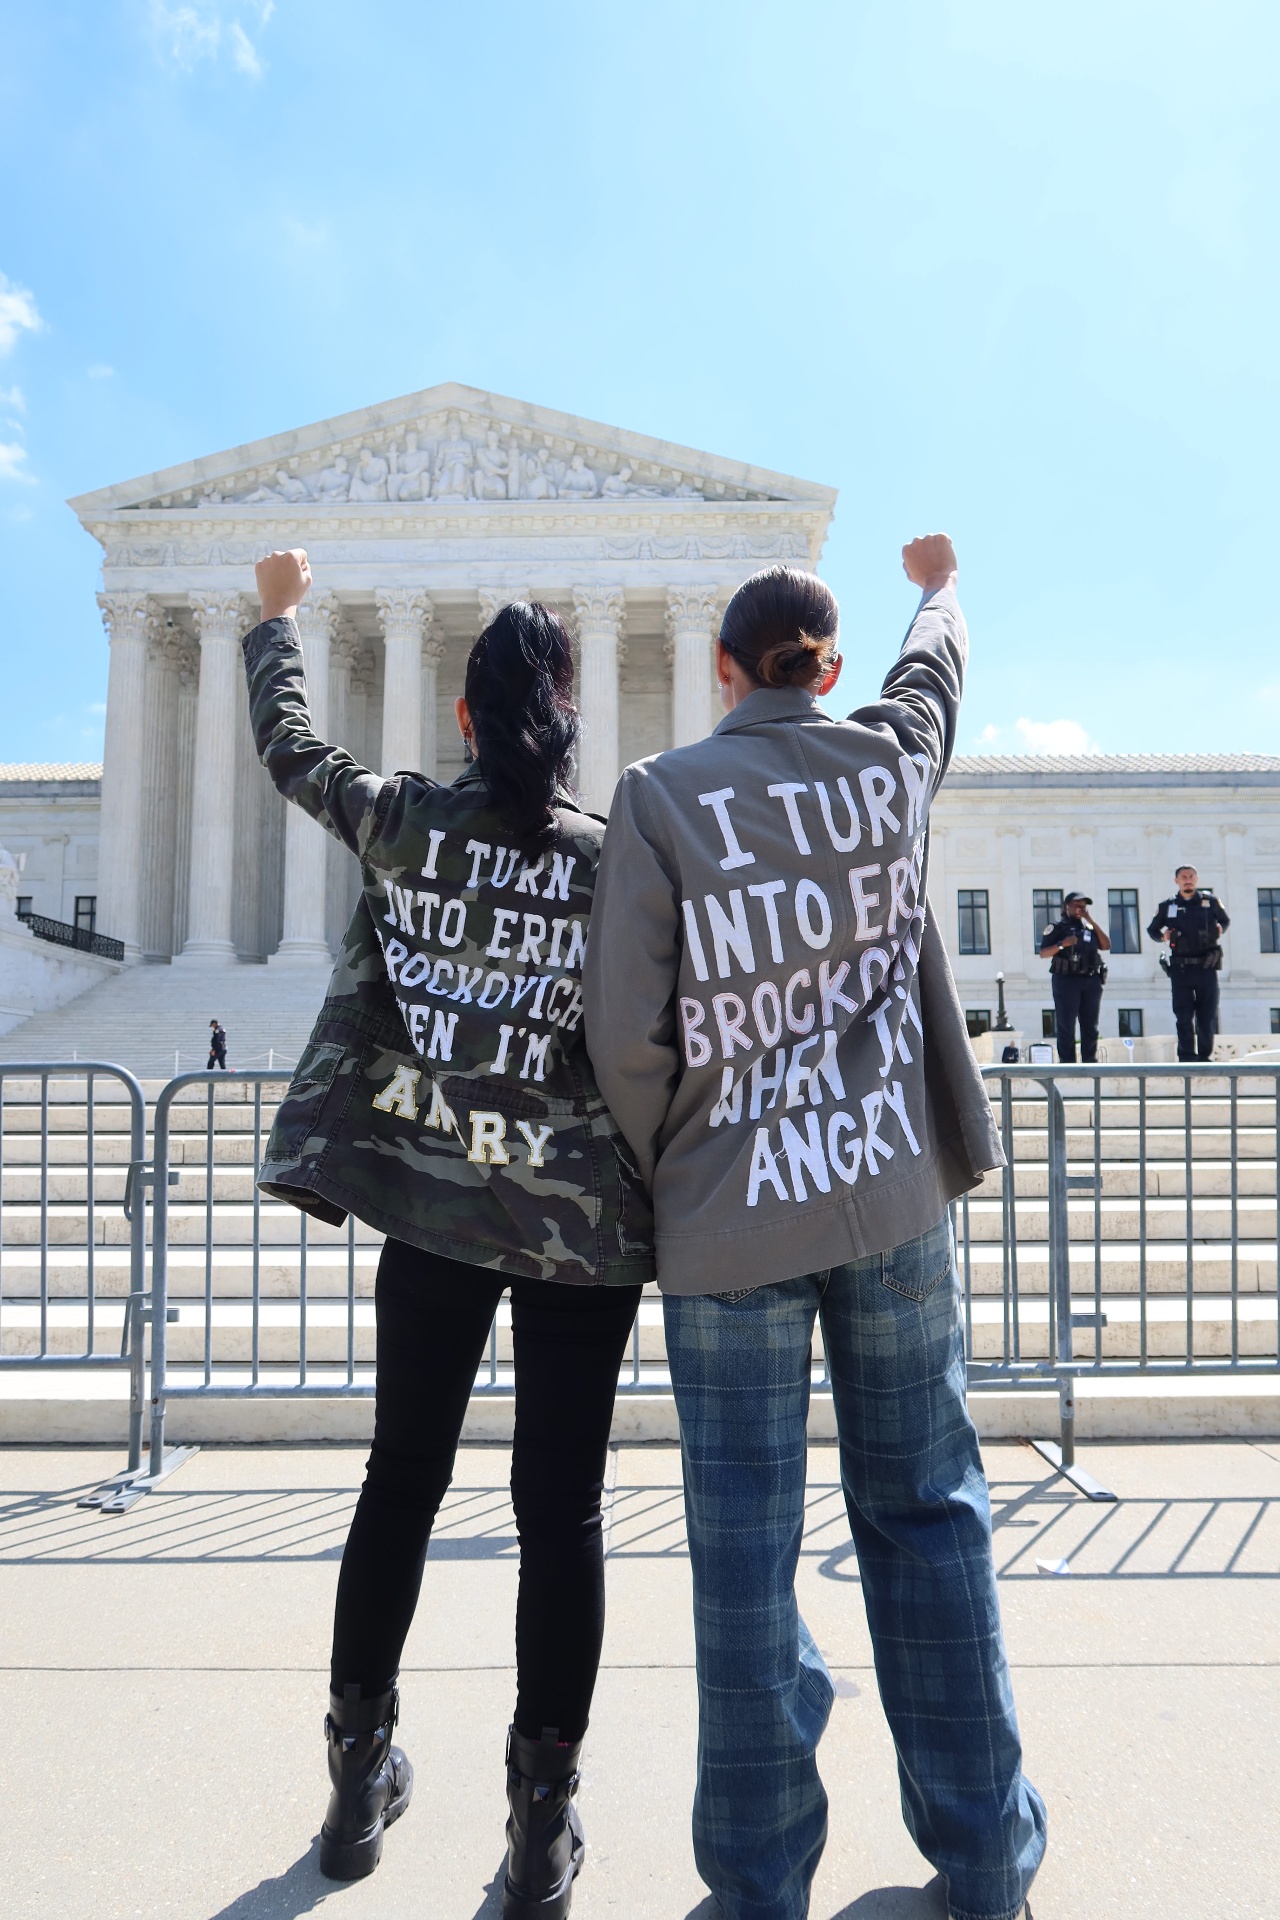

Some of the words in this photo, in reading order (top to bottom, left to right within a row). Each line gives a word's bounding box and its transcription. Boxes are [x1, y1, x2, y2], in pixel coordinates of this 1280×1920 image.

[697, 786, 756, 871] I
[767, 752, 930, 856] TURN
[382, 878, 467, 948] INTO
[420, 829, 446, 880] I
[465, 838, 577, 901] TURN
[374, 928, 584, 1032] ROCKOVICH
[681, 878, 834, 982] INTO
[489, 1023, 551, 1082] I'M
[708, 1030, 848, 1128] WHEN
[372, 1064, 555, 1169] ANRY
[746, 1080, 923, 1207] ANGRY
